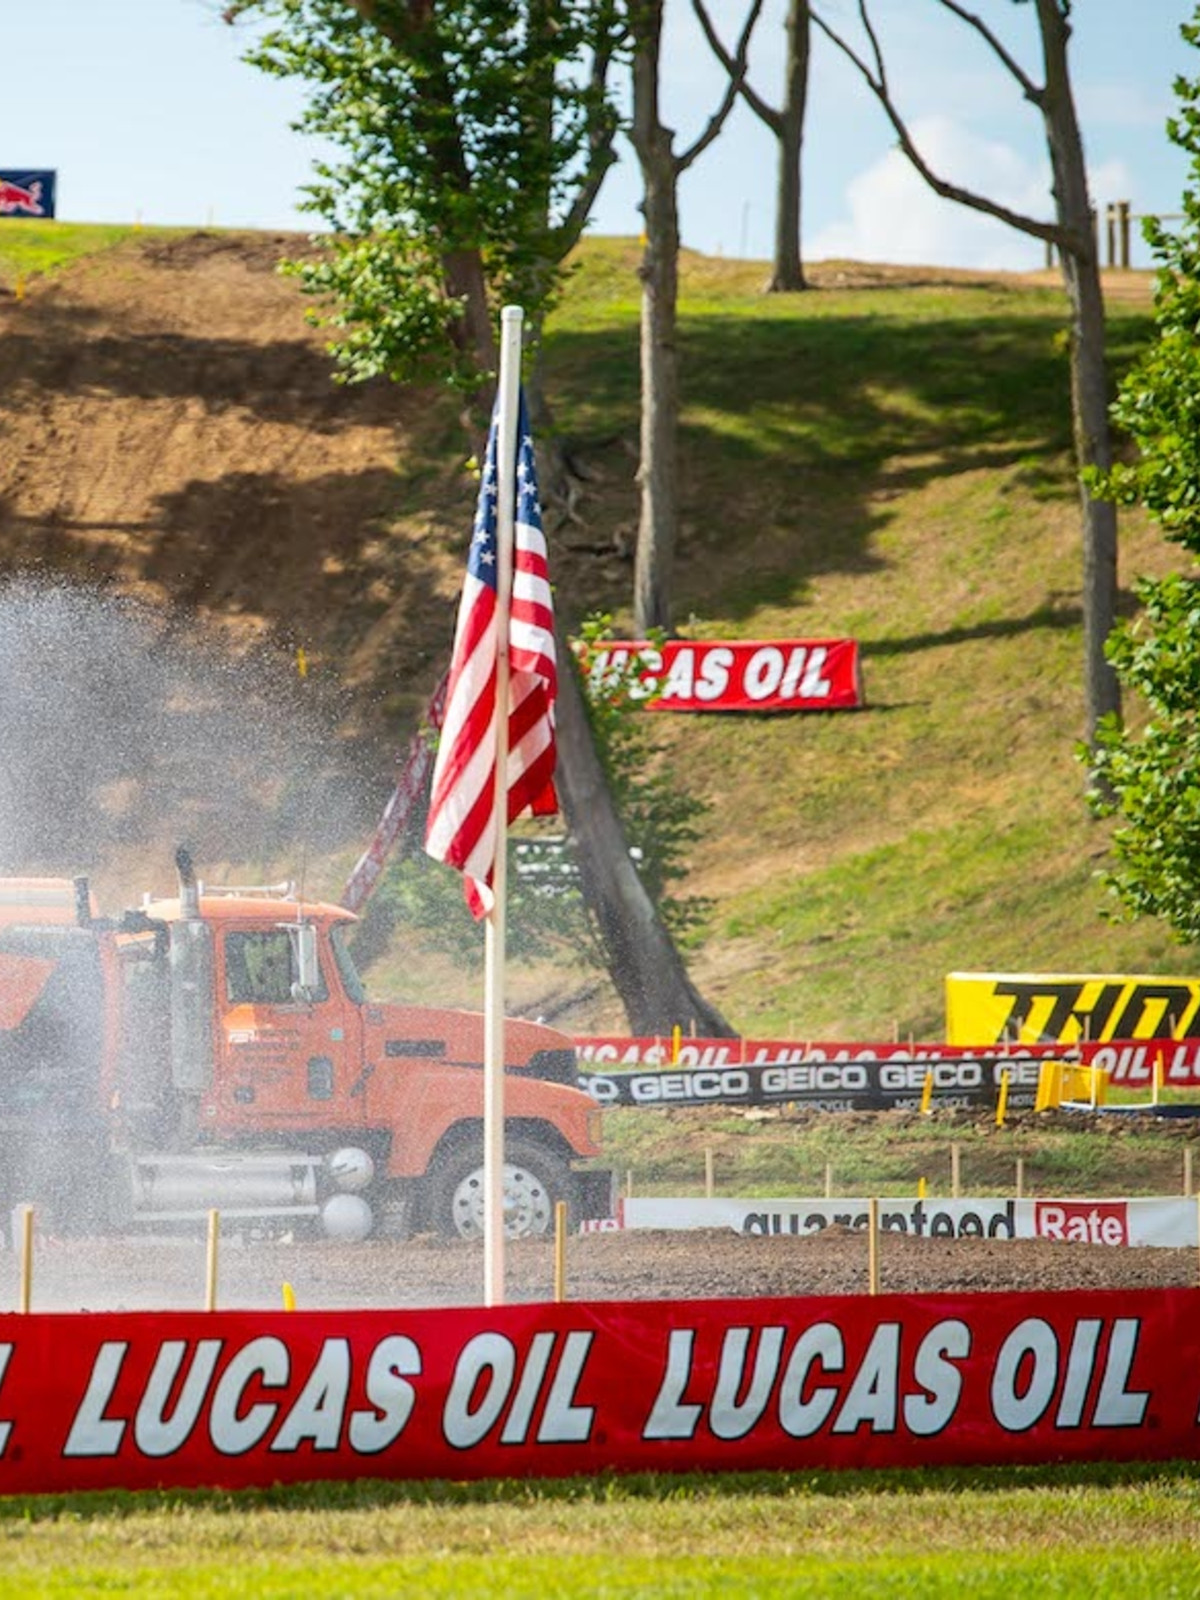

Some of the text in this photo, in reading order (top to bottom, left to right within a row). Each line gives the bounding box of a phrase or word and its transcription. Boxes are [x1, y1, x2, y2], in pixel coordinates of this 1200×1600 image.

[743, 647, 831, 700] OIL
[630, 1070, 749, 1101] GEICO
[761, 1065, 867, 1093] GEICO
[1040, 1206, 1123, 1246] Rate
[61, 1331, 596, 1457] LUCAS OIL
[640, 1316, 1151, 1440] LUCAS OIL
